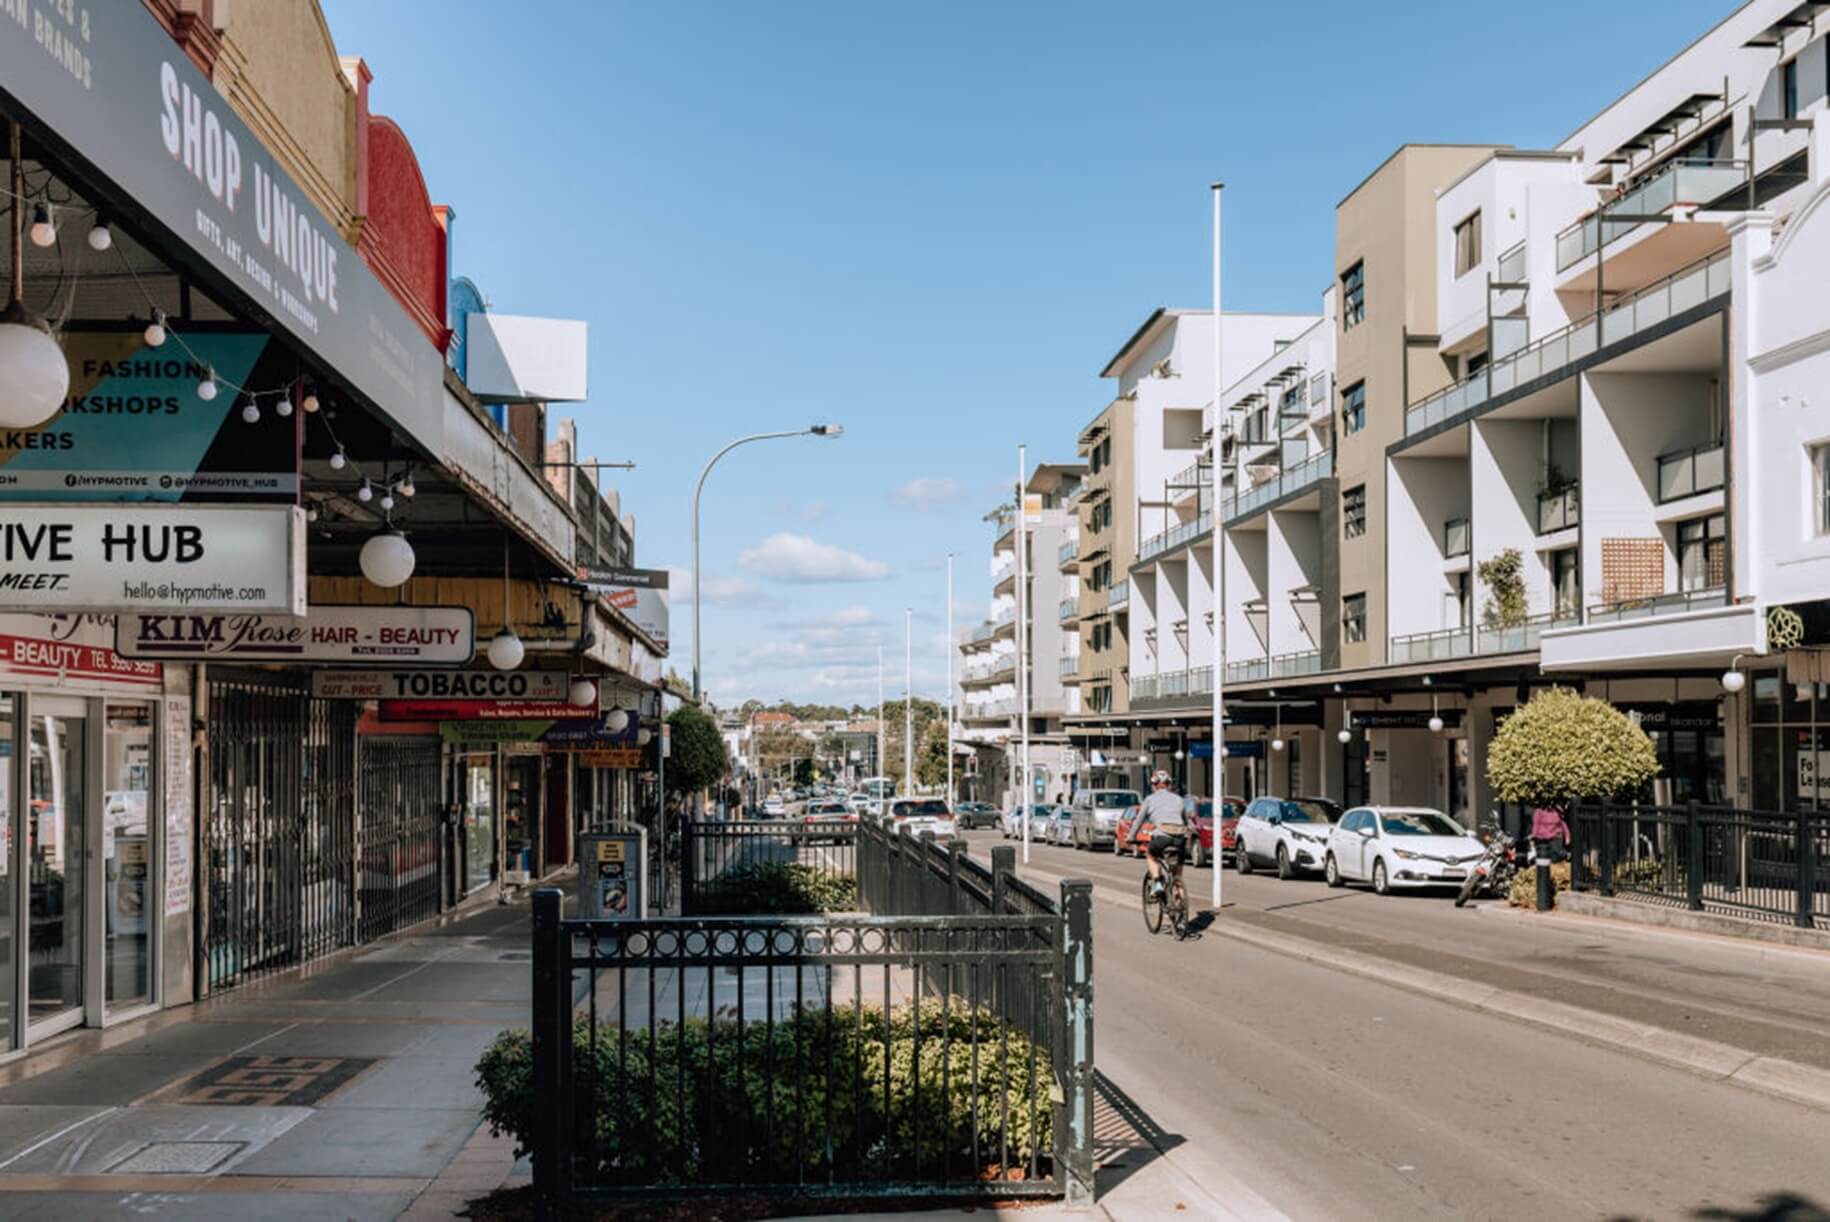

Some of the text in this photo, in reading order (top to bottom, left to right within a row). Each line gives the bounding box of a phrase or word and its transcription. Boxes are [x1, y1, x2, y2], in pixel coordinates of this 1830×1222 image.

[34, 8, 91, 89] BRANDS
[160, 60, 338, 313] SHOP UNIQUE
[83, 359, 201, 379] FASHION
[0, 431, 75, 451] KERS
[0, 523, 204, 563] IVE HUB
[124, 581, 266, 605] hello@hypmotive.com
[137, 615, 224, 642] KIM
[207, 614, 308, 652] Rose
[311, 627, 358, 644] HAIR
[379, 628, 460, 645] BEAUTY
[14, 640, 81, 668] BEAUTY
[91, 650, 109, 670] TEL
[393, 673, 528, 697] TOBACCO
